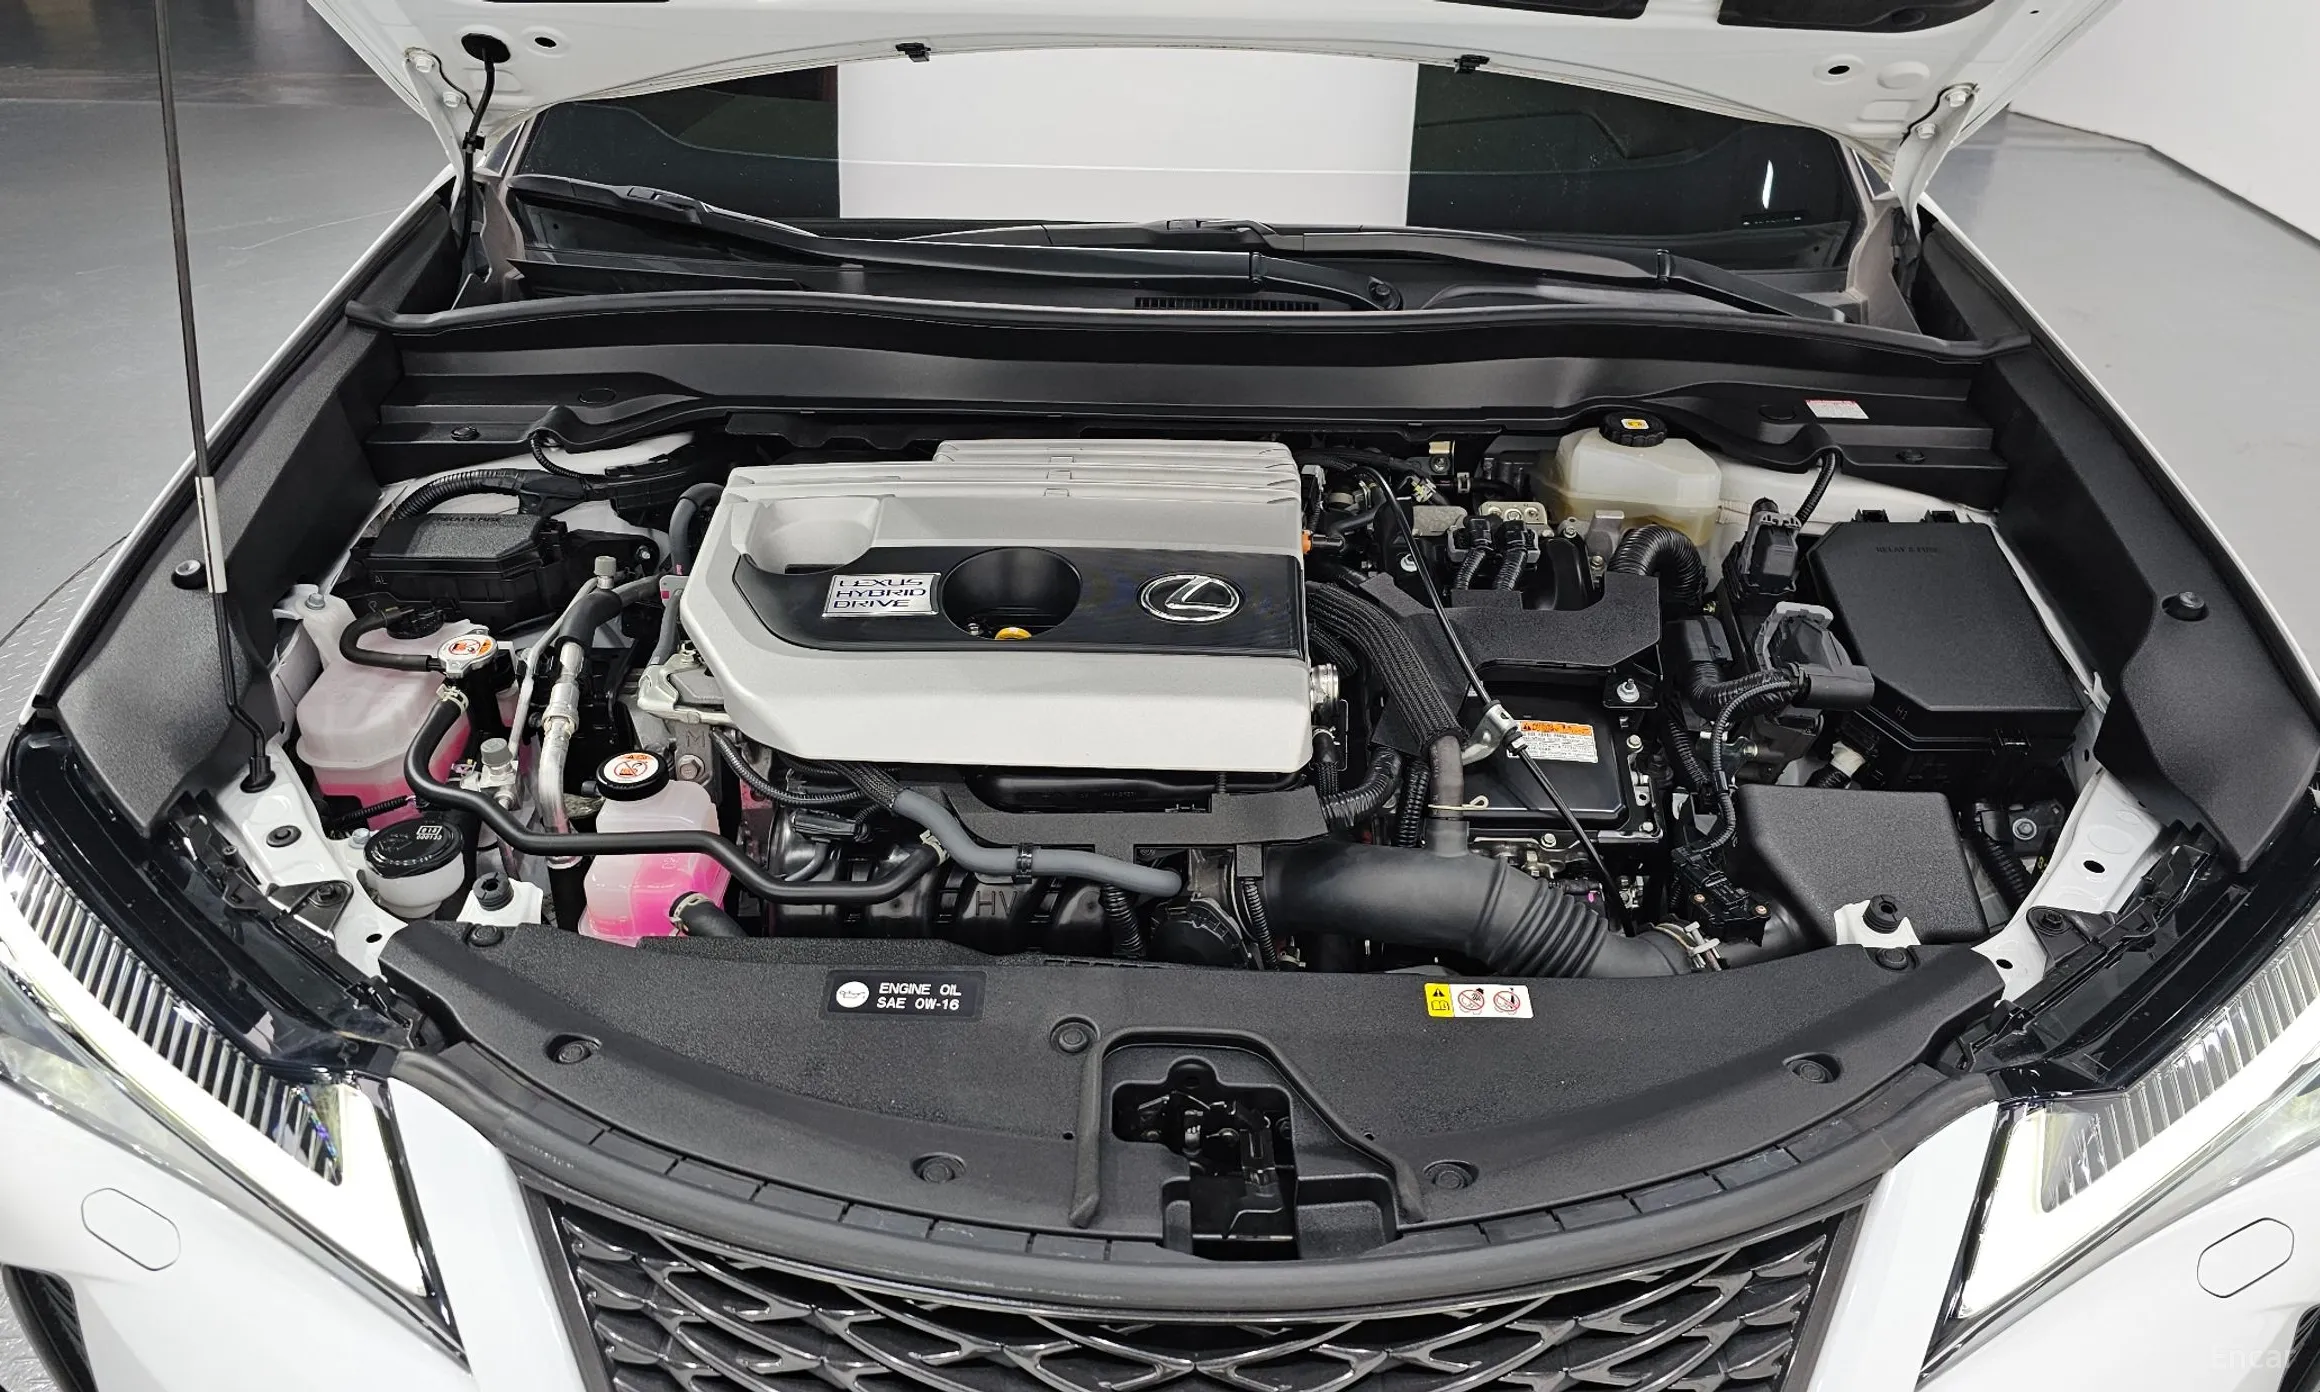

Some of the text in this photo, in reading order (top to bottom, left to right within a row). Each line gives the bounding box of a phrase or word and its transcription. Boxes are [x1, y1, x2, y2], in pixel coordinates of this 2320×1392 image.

[839, 578, 923, 587] LEXUS
[836, 588, 926, 598] HYBRID
[833, 599, 911, 609] DRIVE
[975, 890, 1018, 917] HV
[878, 982, 962, 996] ENGINE OIL
[876, 997, 907, 1009] SAE
